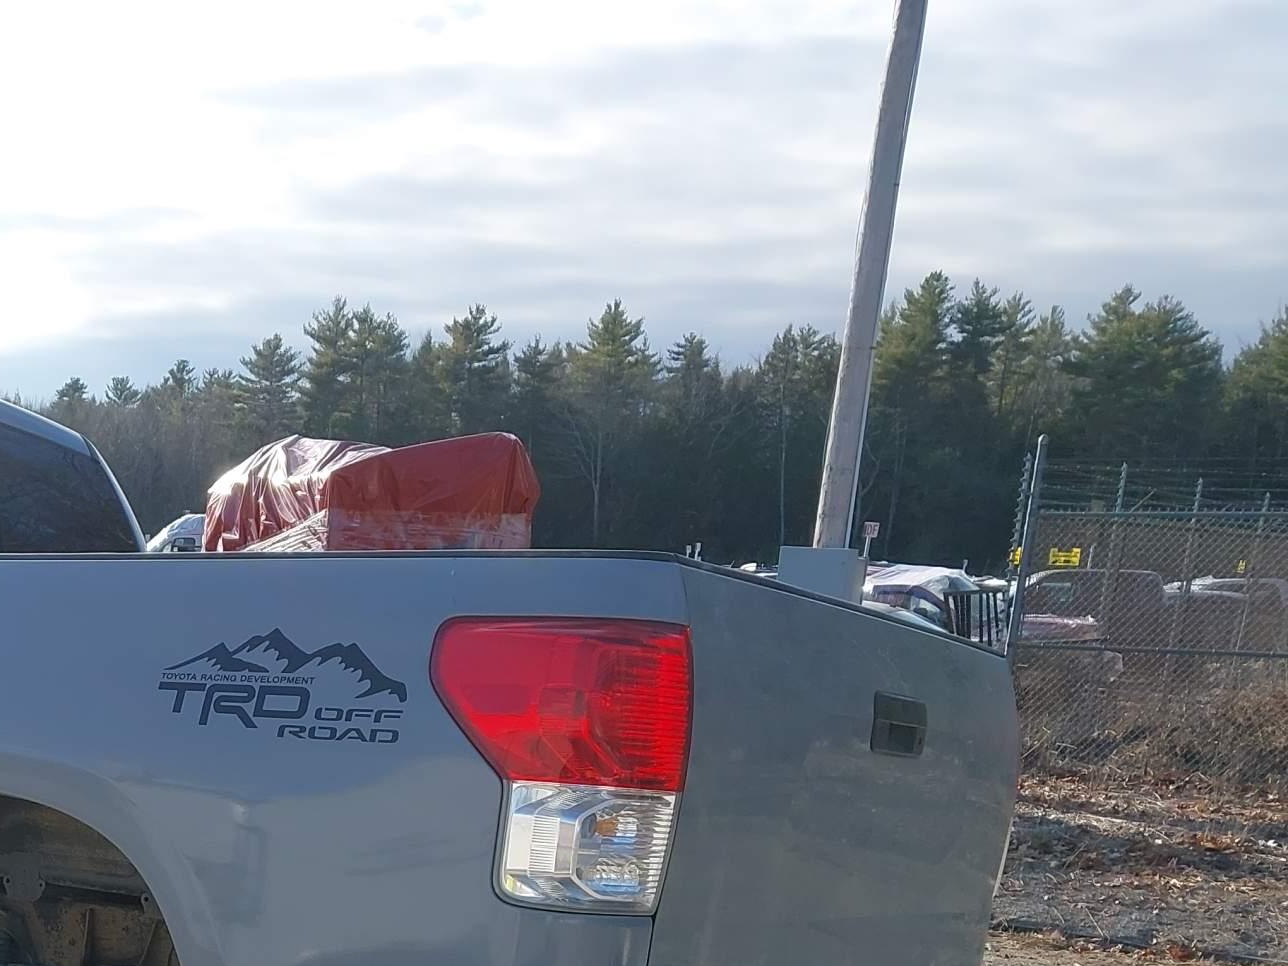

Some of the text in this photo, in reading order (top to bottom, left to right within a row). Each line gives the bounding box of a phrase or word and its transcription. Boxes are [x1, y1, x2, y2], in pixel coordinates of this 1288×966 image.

[162, 672, 315, 685] TOYOTA RACING DEVELOPMENT
[158, 681, 311, 728] TRD
[314, 707, 404, 723] OFF
[276, 724, 400, 743] ROAD
